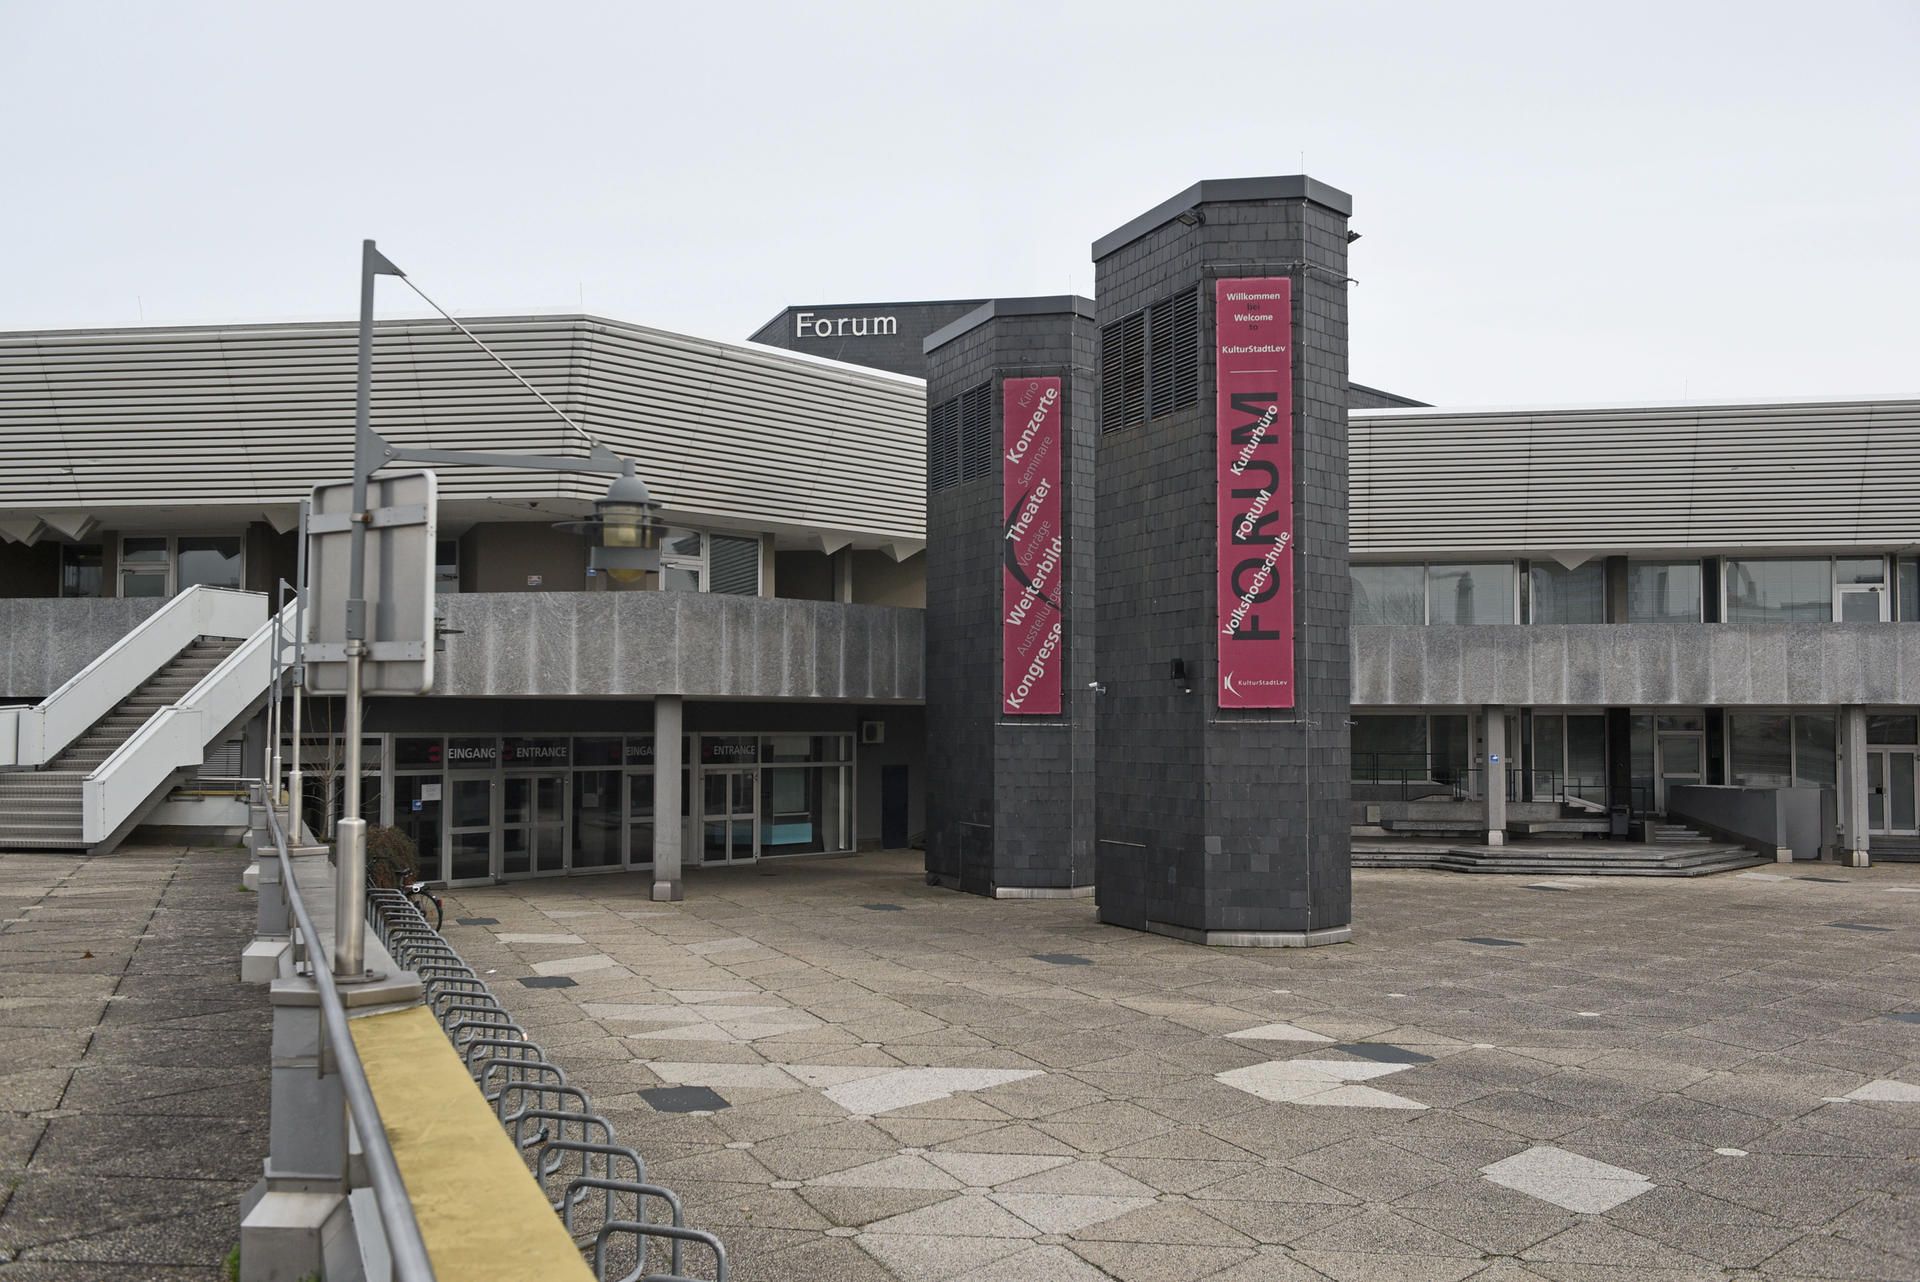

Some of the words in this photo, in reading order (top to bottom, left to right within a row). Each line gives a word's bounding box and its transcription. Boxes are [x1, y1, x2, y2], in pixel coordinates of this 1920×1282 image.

[1226, 292, 1280, 301] Willkommen
[1234, 313, 1273, 322] Welcome
[796, 312, 897, 338] Forum
[1222, 344, 1286, 354] KulturStadtLev
[1018, 382, 1039, 408] Kino
[1006, 387, 1058, 465] Konzerte
[1230, 404, 1278, 476] Kulturbüro
[1017, 436, 1053, 488] Seminare
[1005, 477, 1051, 542] Theater
[1230, 391, 1281, 641] FORUM
[1235, 489, 1272, 541] FORUM
[1017, 520, 1052, 567] Vorträge
[1006, 536, 1062, 626] Weiterbild
[1222, 530, 1290, 636] Volkshochschule
[1006, 622, 1062, 709] Kongresse
[448, 748, 496, 759] EINGANG
[516, 746, 567, 758] ENTRANCE
[624, 745, 655, 757] EINGA
[713, 745, 756, 756] ENTRANCE
